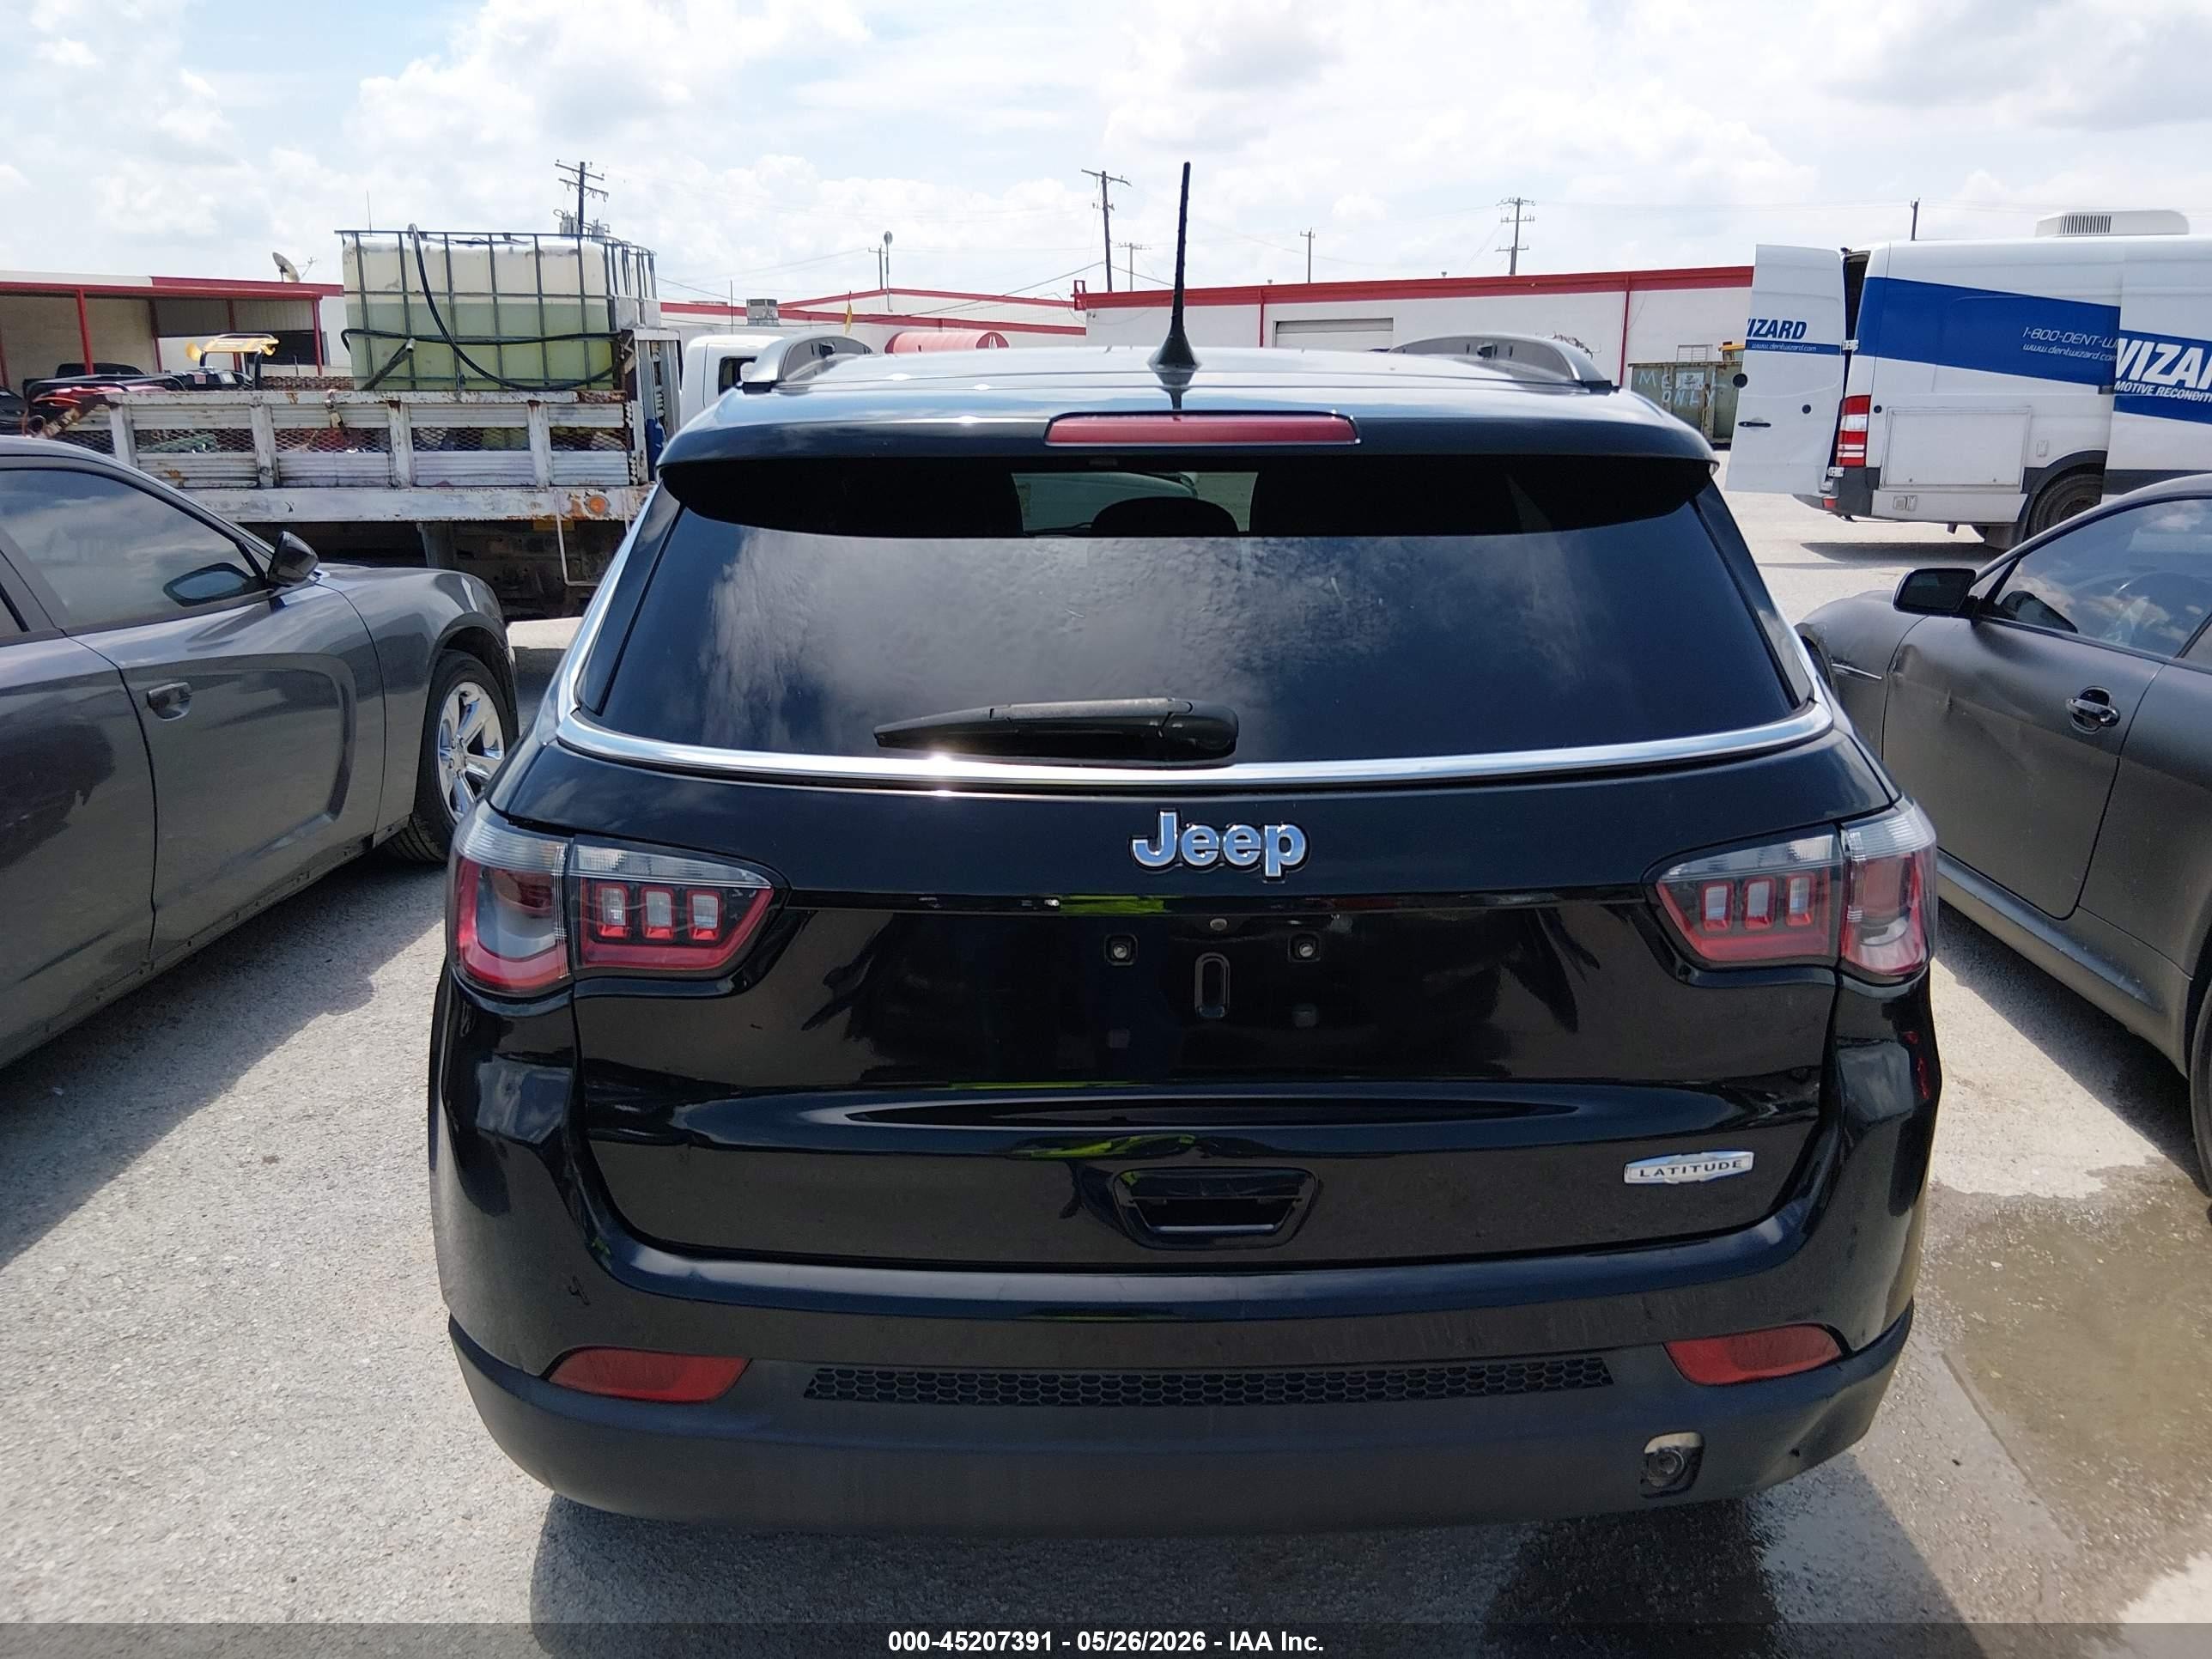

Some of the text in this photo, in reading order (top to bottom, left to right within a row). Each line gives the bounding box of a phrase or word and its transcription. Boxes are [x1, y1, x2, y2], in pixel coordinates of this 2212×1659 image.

[1747, 318, 1808, 340] IZARD
[2022, 326, 2118, 349] 1-800-DENT-W
[1638, 370, 1729, 390] MEL
[1662, 389, 1717, 406] ONLY
[1131, 810, 1308, 878] Jeep
[1639, 1159, 1743, 1177] LATITUDE
